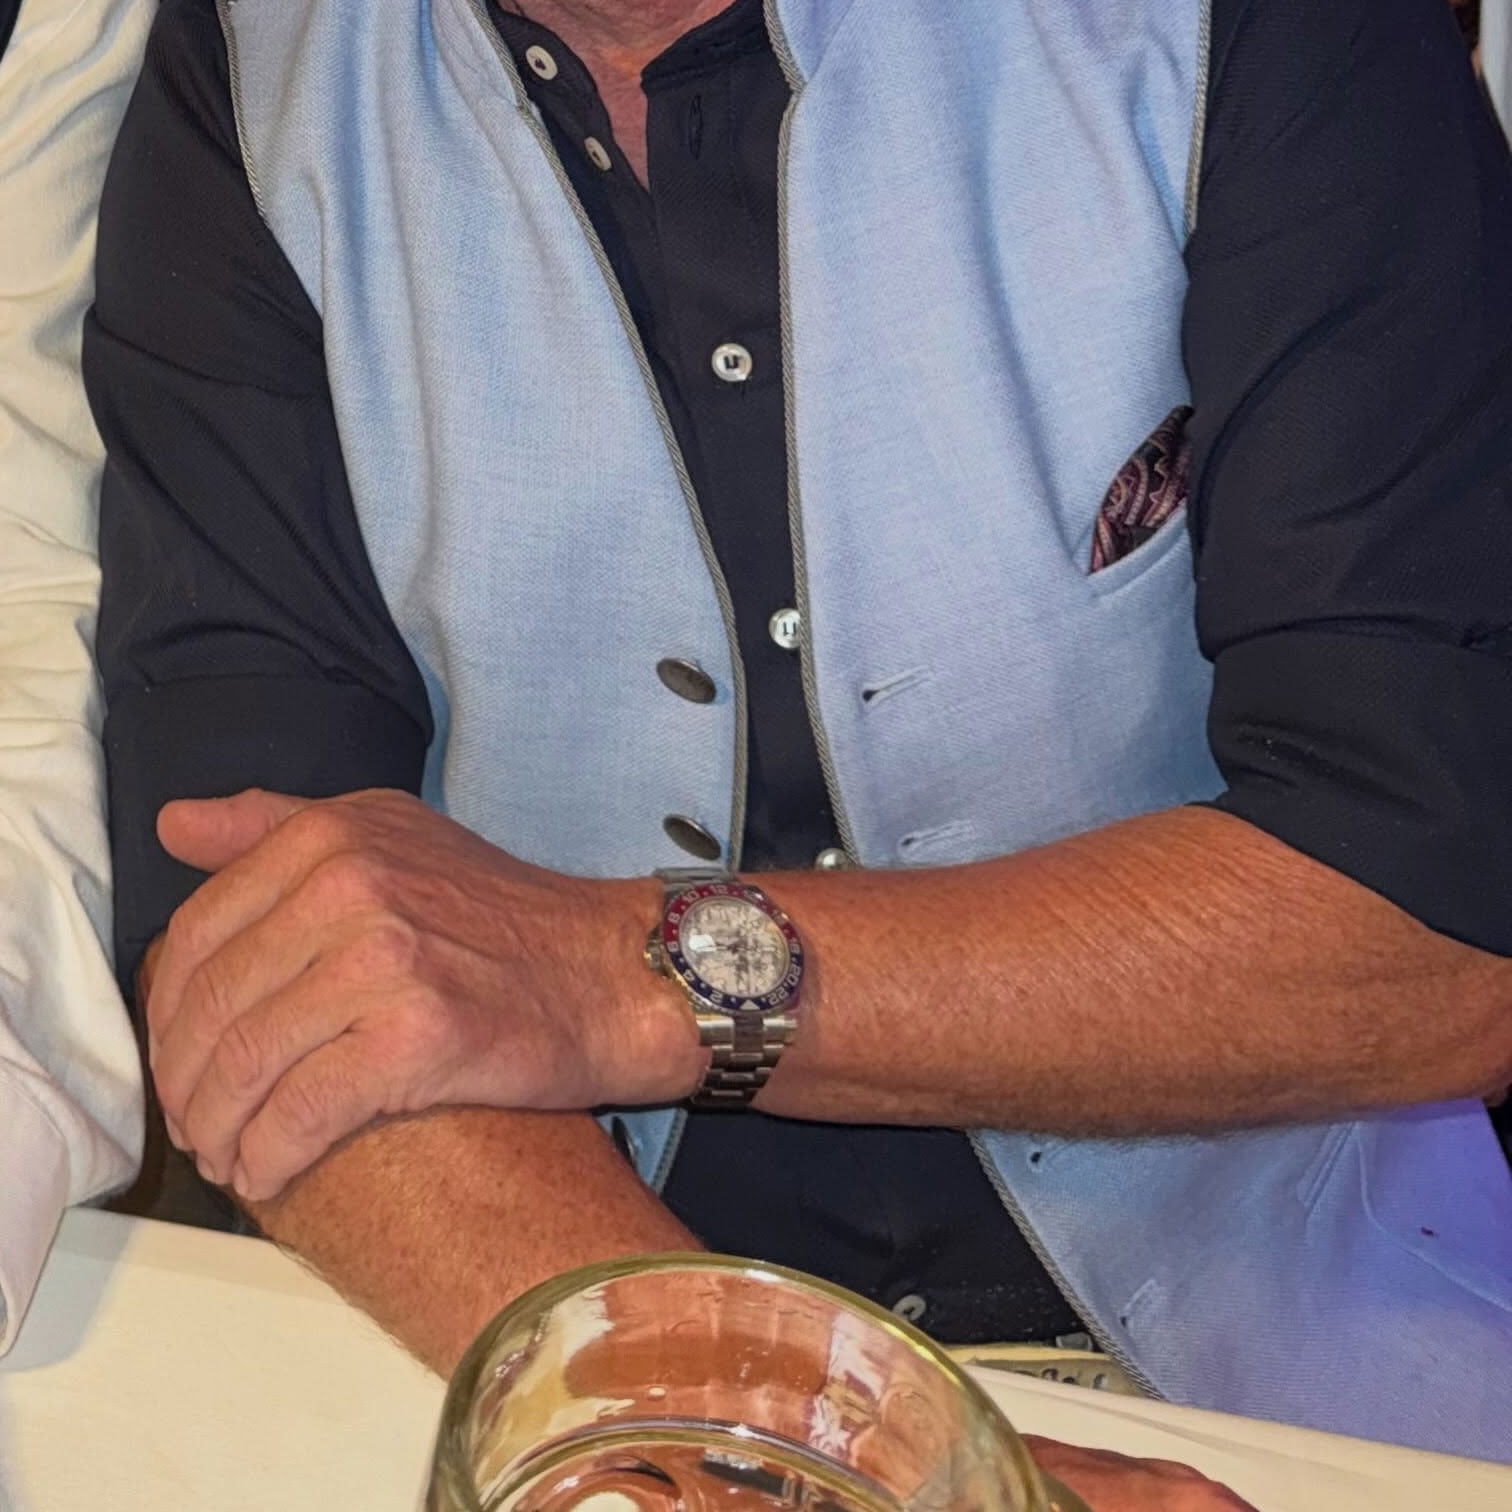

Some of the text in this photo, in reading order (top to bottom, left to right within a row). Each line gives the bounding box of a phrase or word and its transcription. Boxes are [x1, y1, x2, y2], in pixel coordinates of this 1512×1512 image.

[708, 885, 728, 894] 12
[681, 890, 700, 902] 10
[683, 969, 695, 981] 4
[710, 990, 724, 1003] 2
[768, 987, 788, 1005] 22
